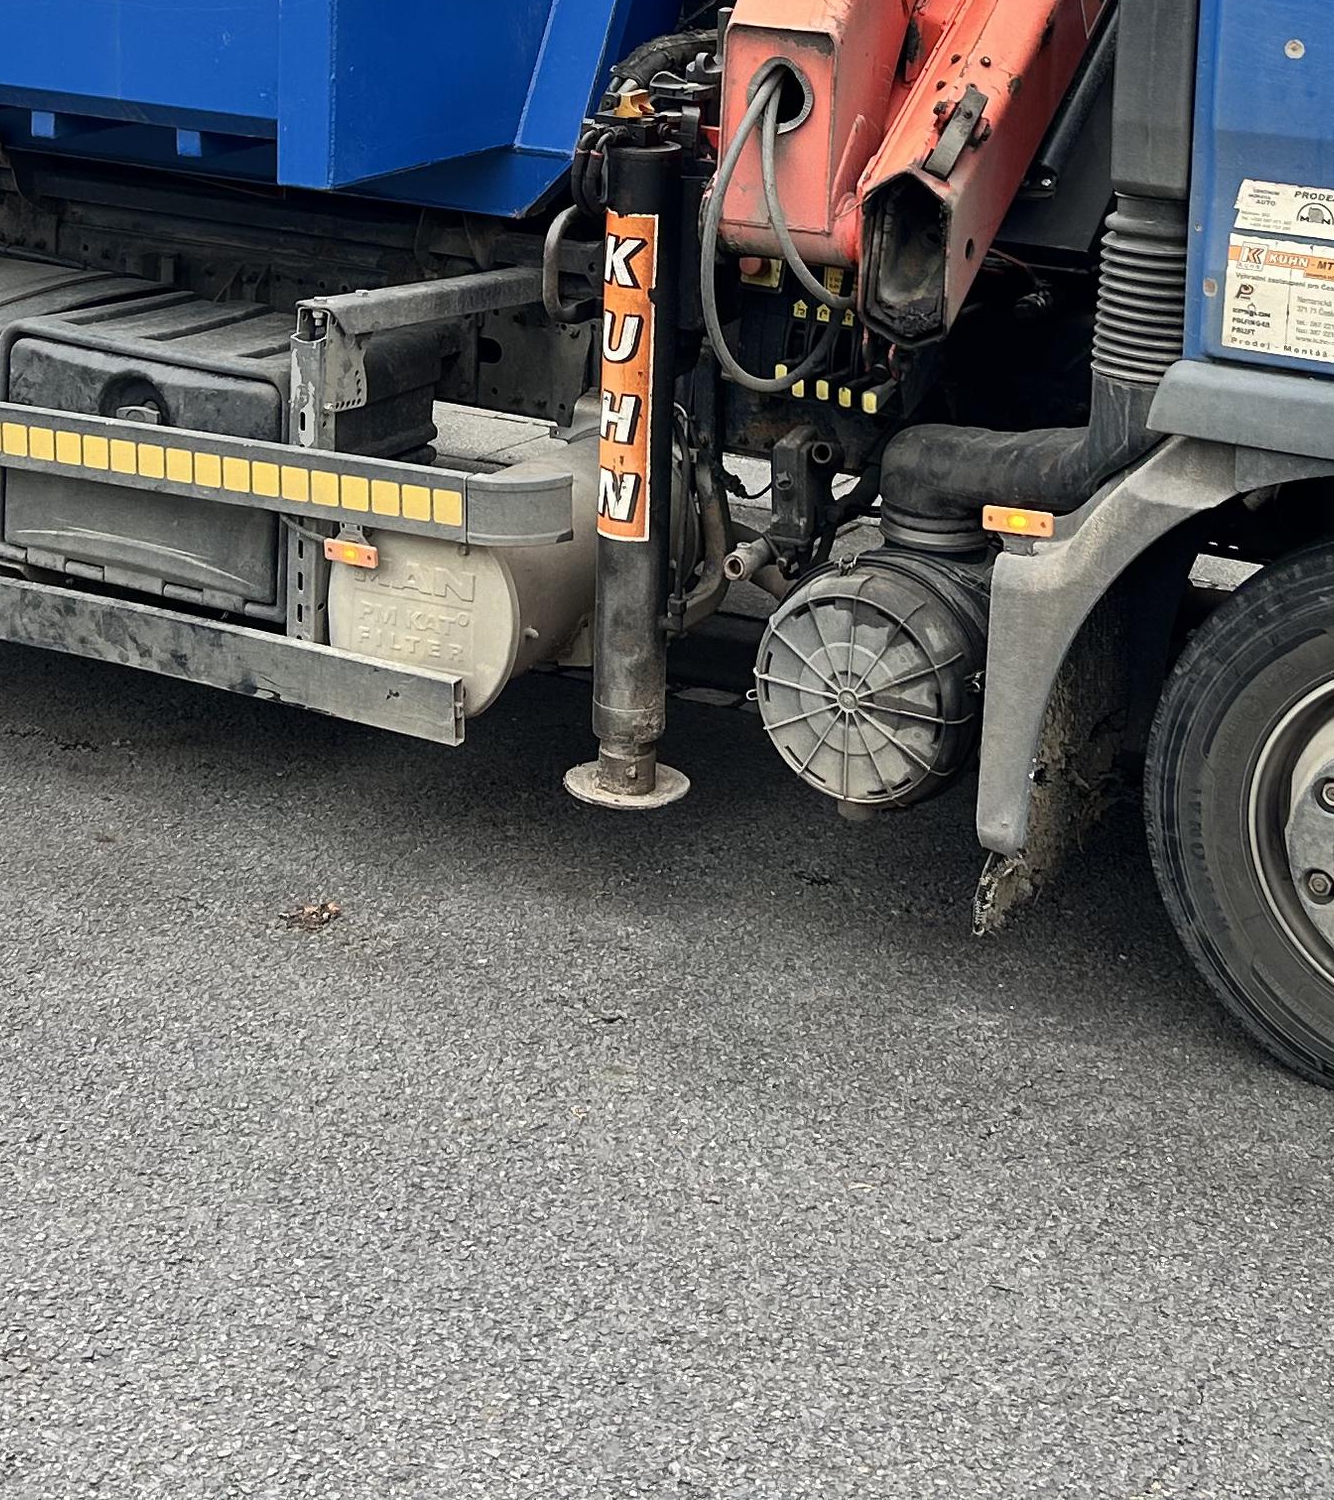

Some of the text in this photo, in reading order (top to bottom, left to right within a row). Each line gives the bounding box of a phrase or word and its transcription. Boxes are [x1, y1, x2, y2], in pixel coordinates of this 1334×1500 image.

[1300, 215, 1332, 226] MN
[1268, 252, 1309, 269] KUHN
[1317, 261, 1334, 272] MT
[1230, 336, 1271, 350] Prodej
[597, 232, 649, 524] KUHN
[353, 560, 476, 603] MAN
[358, 625, 464, 662] FILTER
